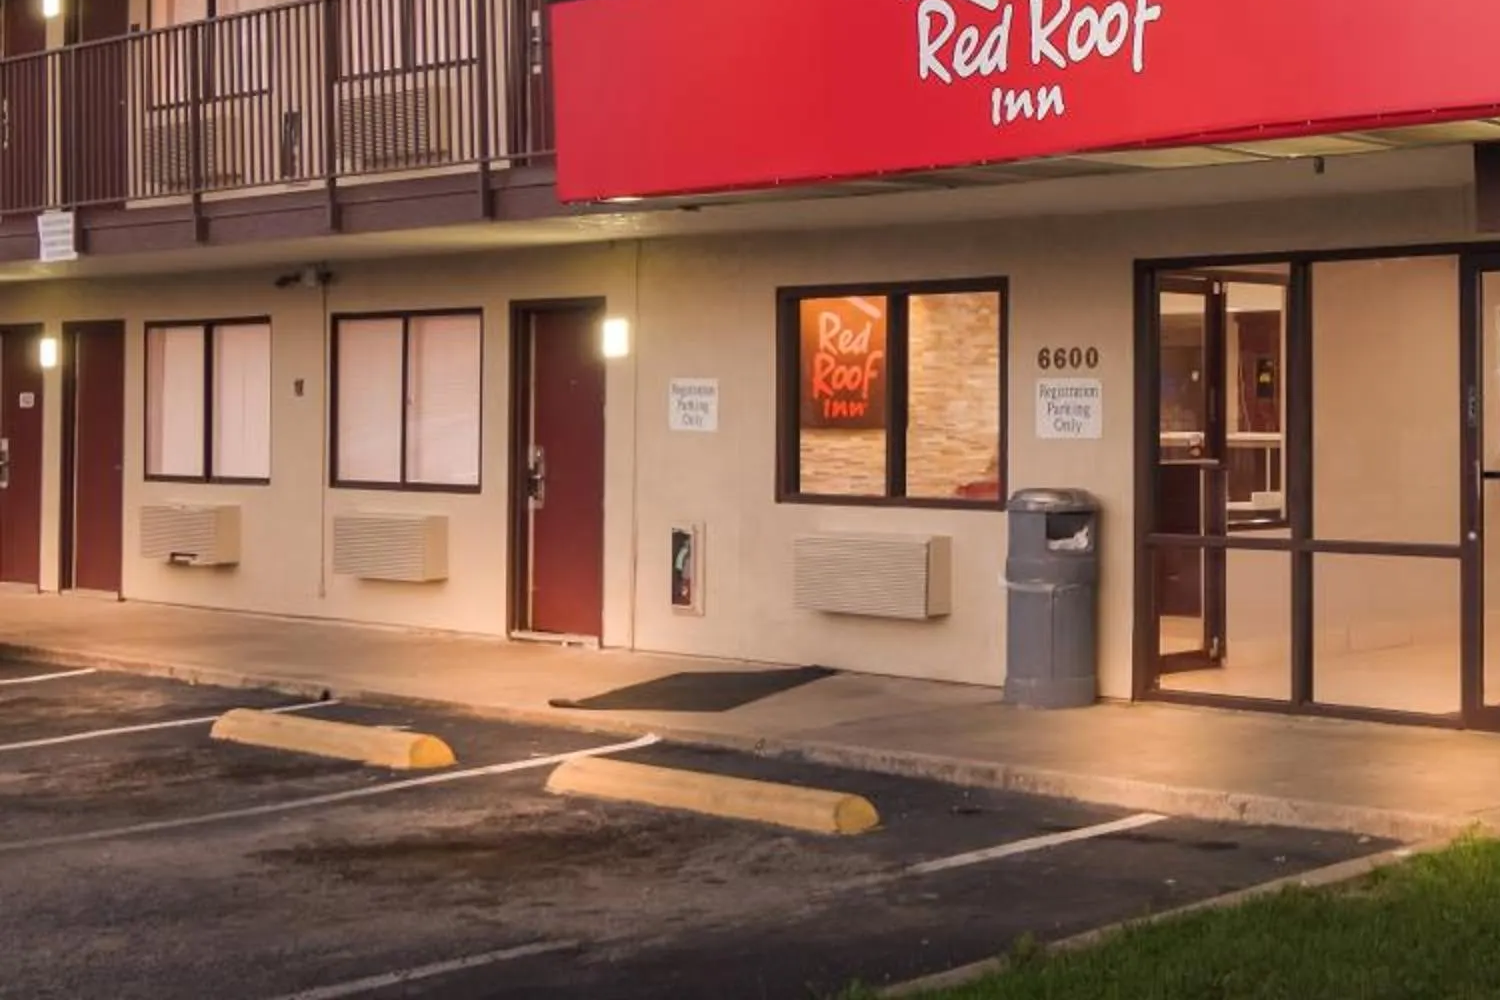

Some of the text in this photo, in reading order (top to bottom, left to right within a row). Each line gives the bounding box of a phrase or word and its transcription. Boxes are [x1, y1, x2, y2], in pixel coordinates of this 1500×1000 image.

[818, 310, 872, 356] Red
[1038, 346, 1099, 370] 6600
[812, 350, 883, 400] Roof
[1040, 384, 1099, 399] Registration
[1047, 402, 1091, 419] Parking
[1053, 418, 1082, 433] Only
